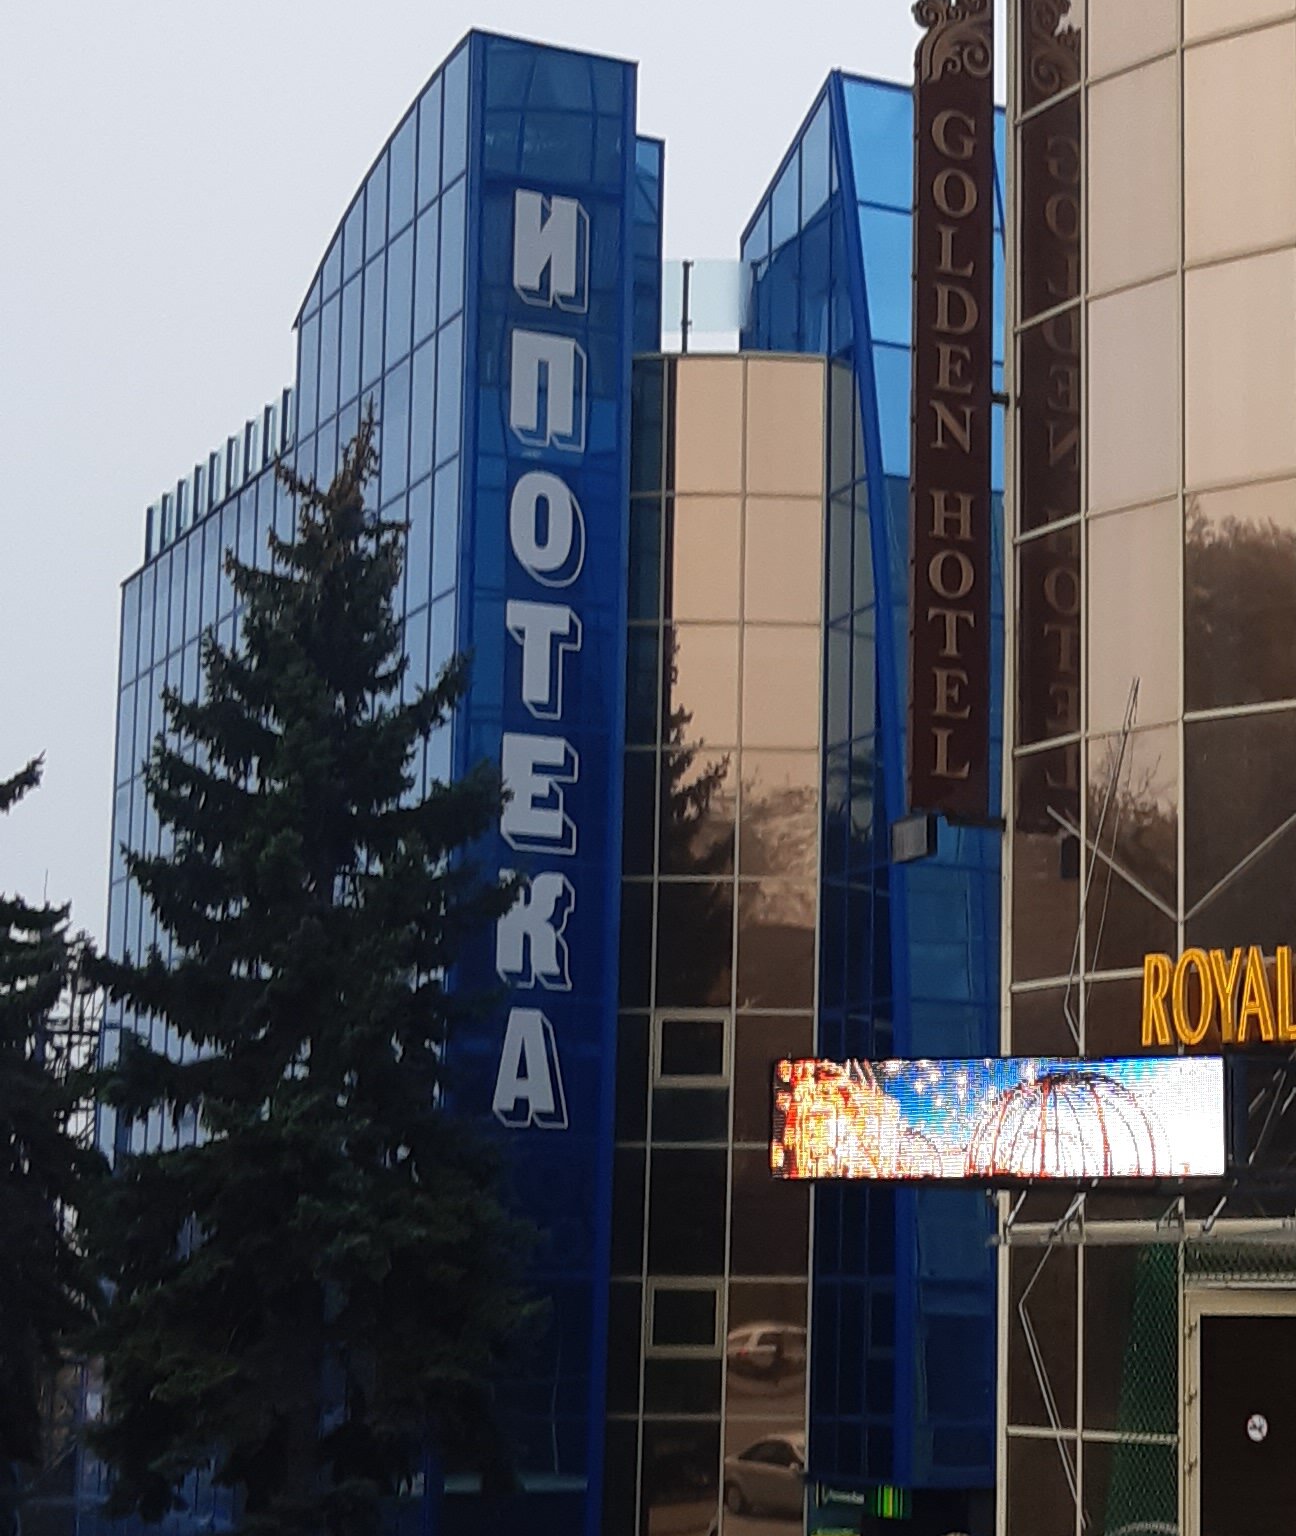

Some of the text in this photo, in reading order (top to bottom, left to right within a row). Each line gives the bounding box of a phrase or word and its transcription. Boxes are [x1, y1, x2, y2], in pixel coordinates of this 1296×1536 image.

[493, 188, 590, 1131] ИПОТЕКА
[928, 109, 979, 780] GOLDEN HOTEL
